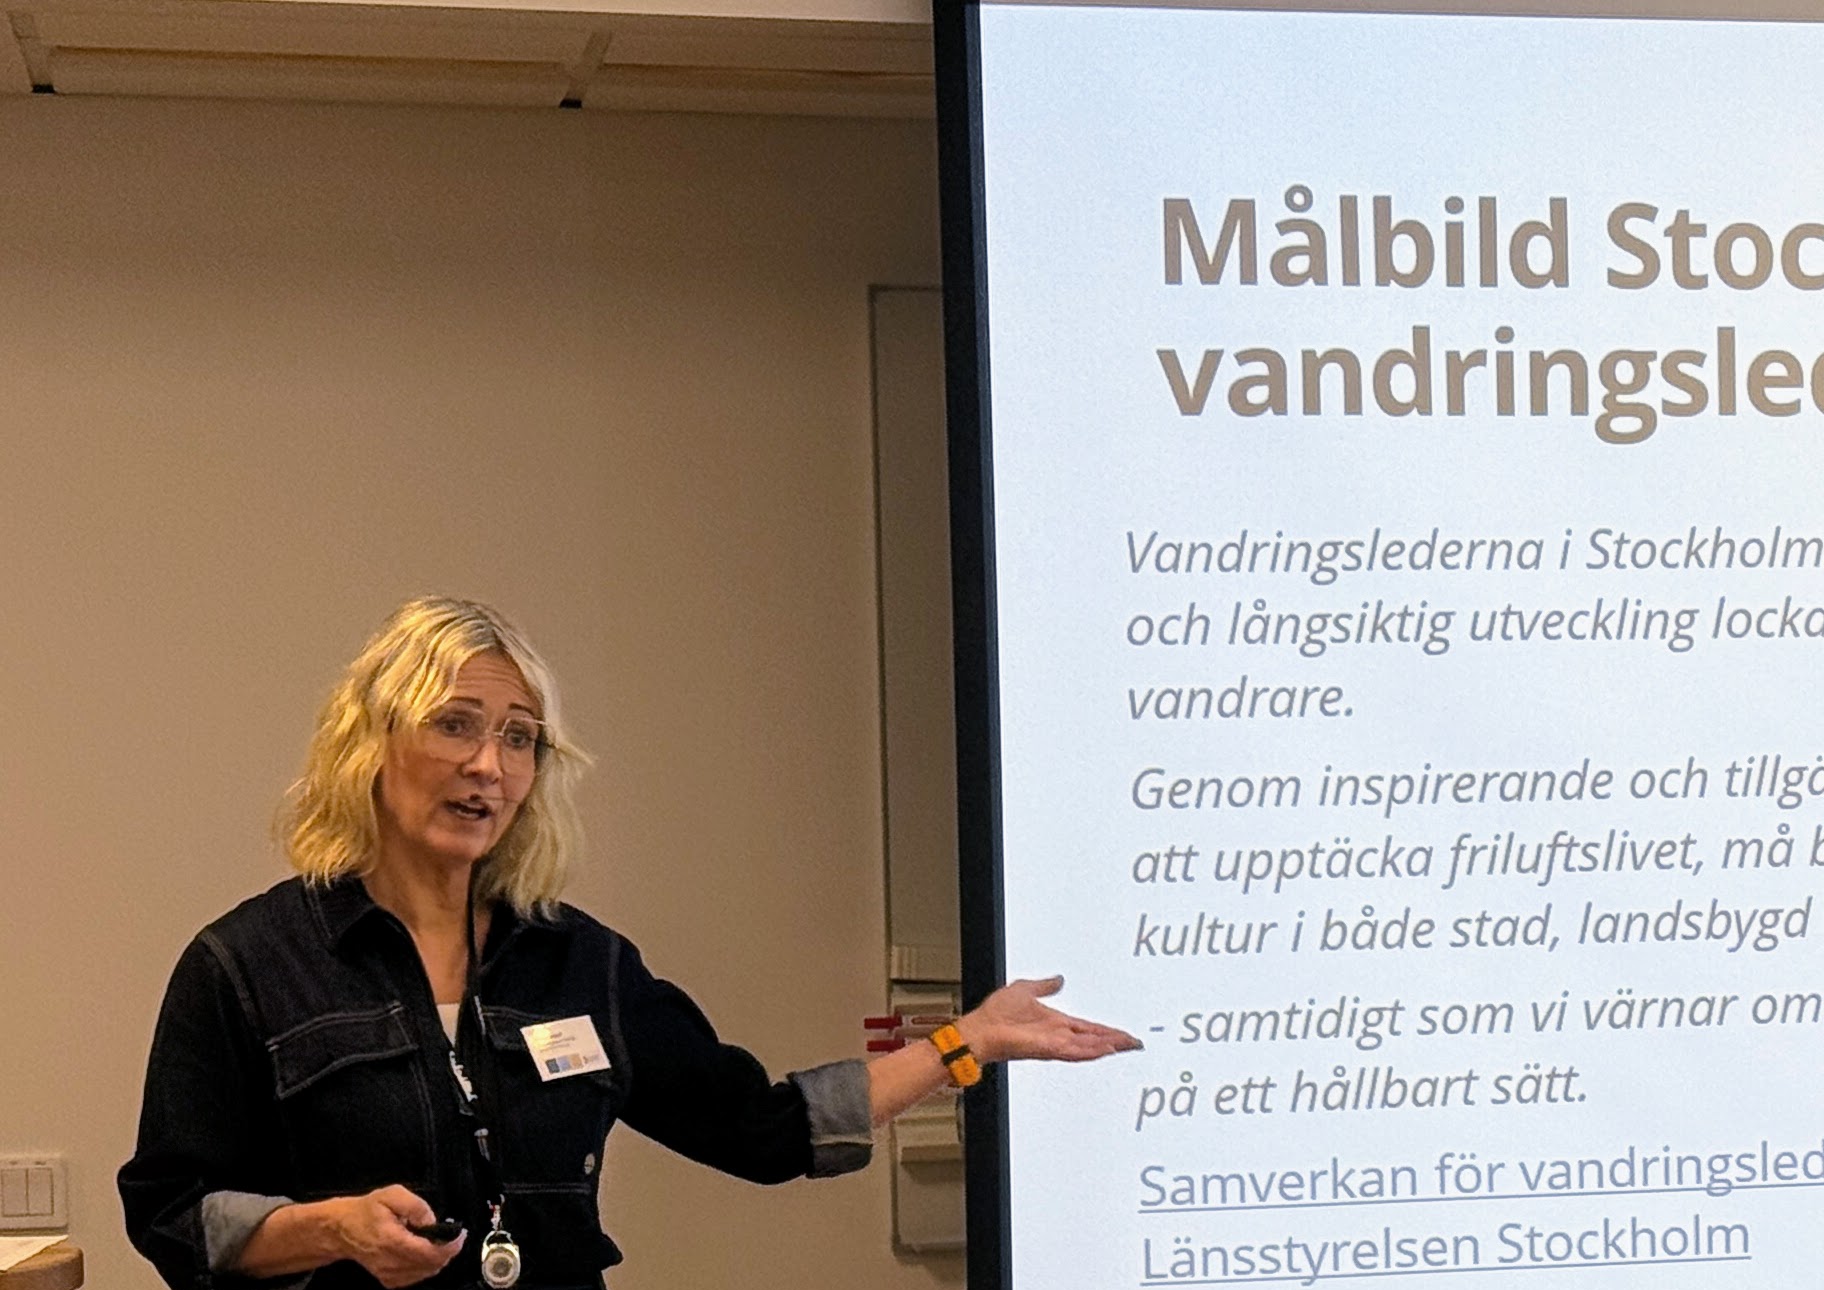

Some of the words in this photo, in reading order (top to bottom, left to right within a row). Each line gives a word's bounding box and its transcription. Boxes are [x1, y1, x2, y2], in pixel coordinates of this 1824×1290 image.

[1163, 184, 1569, 289] Målbild
[1127, 527, 1544, 586] Vandringslederna
[1560, 529, 1572, 569] i
[1127, 602, 1210, 646] och
[1228, 598, 1456, 658] långsiktig
[1470, 598, 1700, 653] utveckling
[1129, 675, 1353, 720] vandrare.
[1132, 768, 1301, 810] Genom
[1319, 758, 1613, 819] inspirerande
[1630, 756, 1708, 799] och
[1133, 845, 1199, 883] att
[1214, 835, 1433, 895] upptäcka
[1441, 829, 1703, 890] friluftslivet,
[1722, 823, 1794, 869] må
[1133, 912, 1278, 956] kultur
[1291, 910, 1305, 952] i
[1320, 905, 1435, 951] både
[1449, 903, 1559, 952] stad,
[1578, 896, 1813, 953] landsbygd
[1180, 996, 1405, 1051] samtidigt
[1417, 1003, 1514, 1035] som
[1531, 990, 1569, 1032] vi
[1584, 988, 1739, 1030] värnar
[1752, 993, 1822, 1024] om
[1136, 1071, 1197, 1131] på
[1214, 1076, 1277, 1115] ett
[1290, 1065, 1480, 1113] hållbart
[1491, 1063, 1586, 1105] sätt.
[1138, 1155, 1420, 1210] Samverkan
[1432, 1150, 1506, 1202] för
[1140, 1220, 1481, 1285] Länsstyrelsen
[1496, 1210, 1751, 1265] Stockholm
